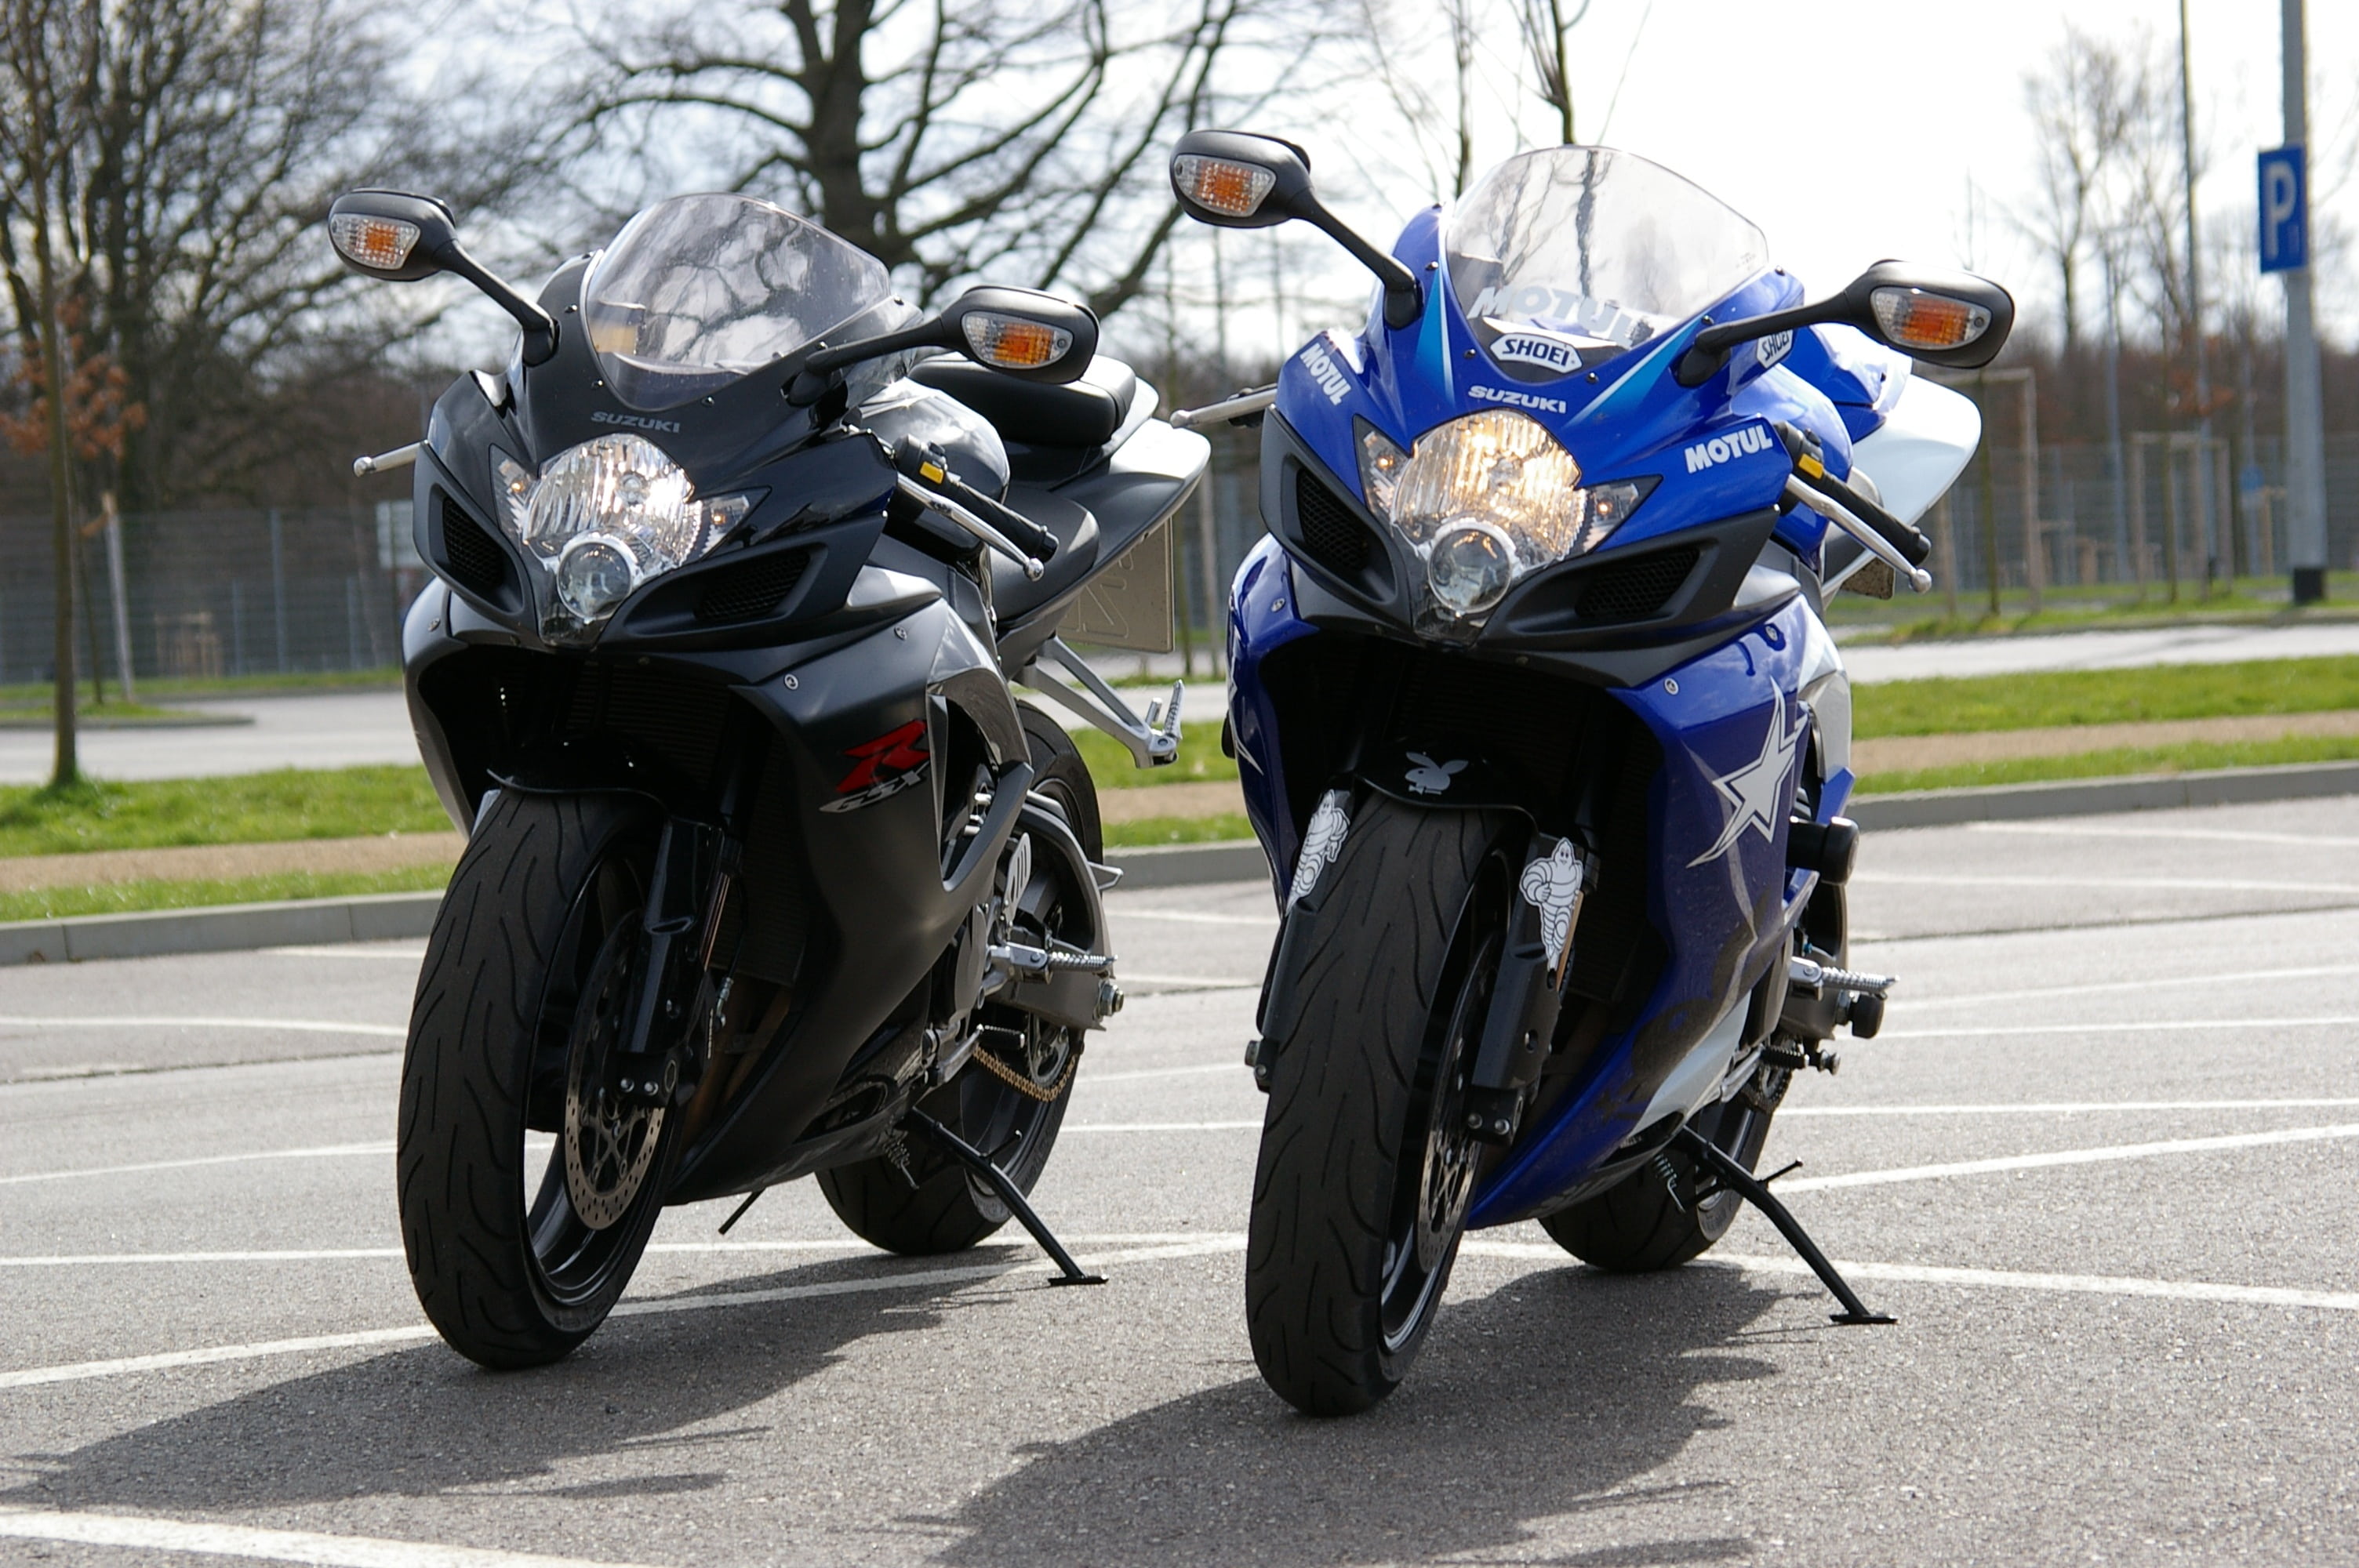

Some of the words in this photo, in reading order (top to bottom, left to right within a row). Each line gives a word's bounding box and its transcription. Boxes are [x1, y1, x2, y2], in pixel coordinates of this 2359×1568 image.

[2263, 161, 2296, 260] P
[1467, 286, 1633, 350] MOTUL
[1299, 342, 1351, 405] MOTUL
[1502, 339, 1570, 366] SHOEI
[591, 411, 680, 433] SUZUKI
[1467, 385, 1567, 414] SUZUKI
[1685, 424, 1773, 474] MOTUL
